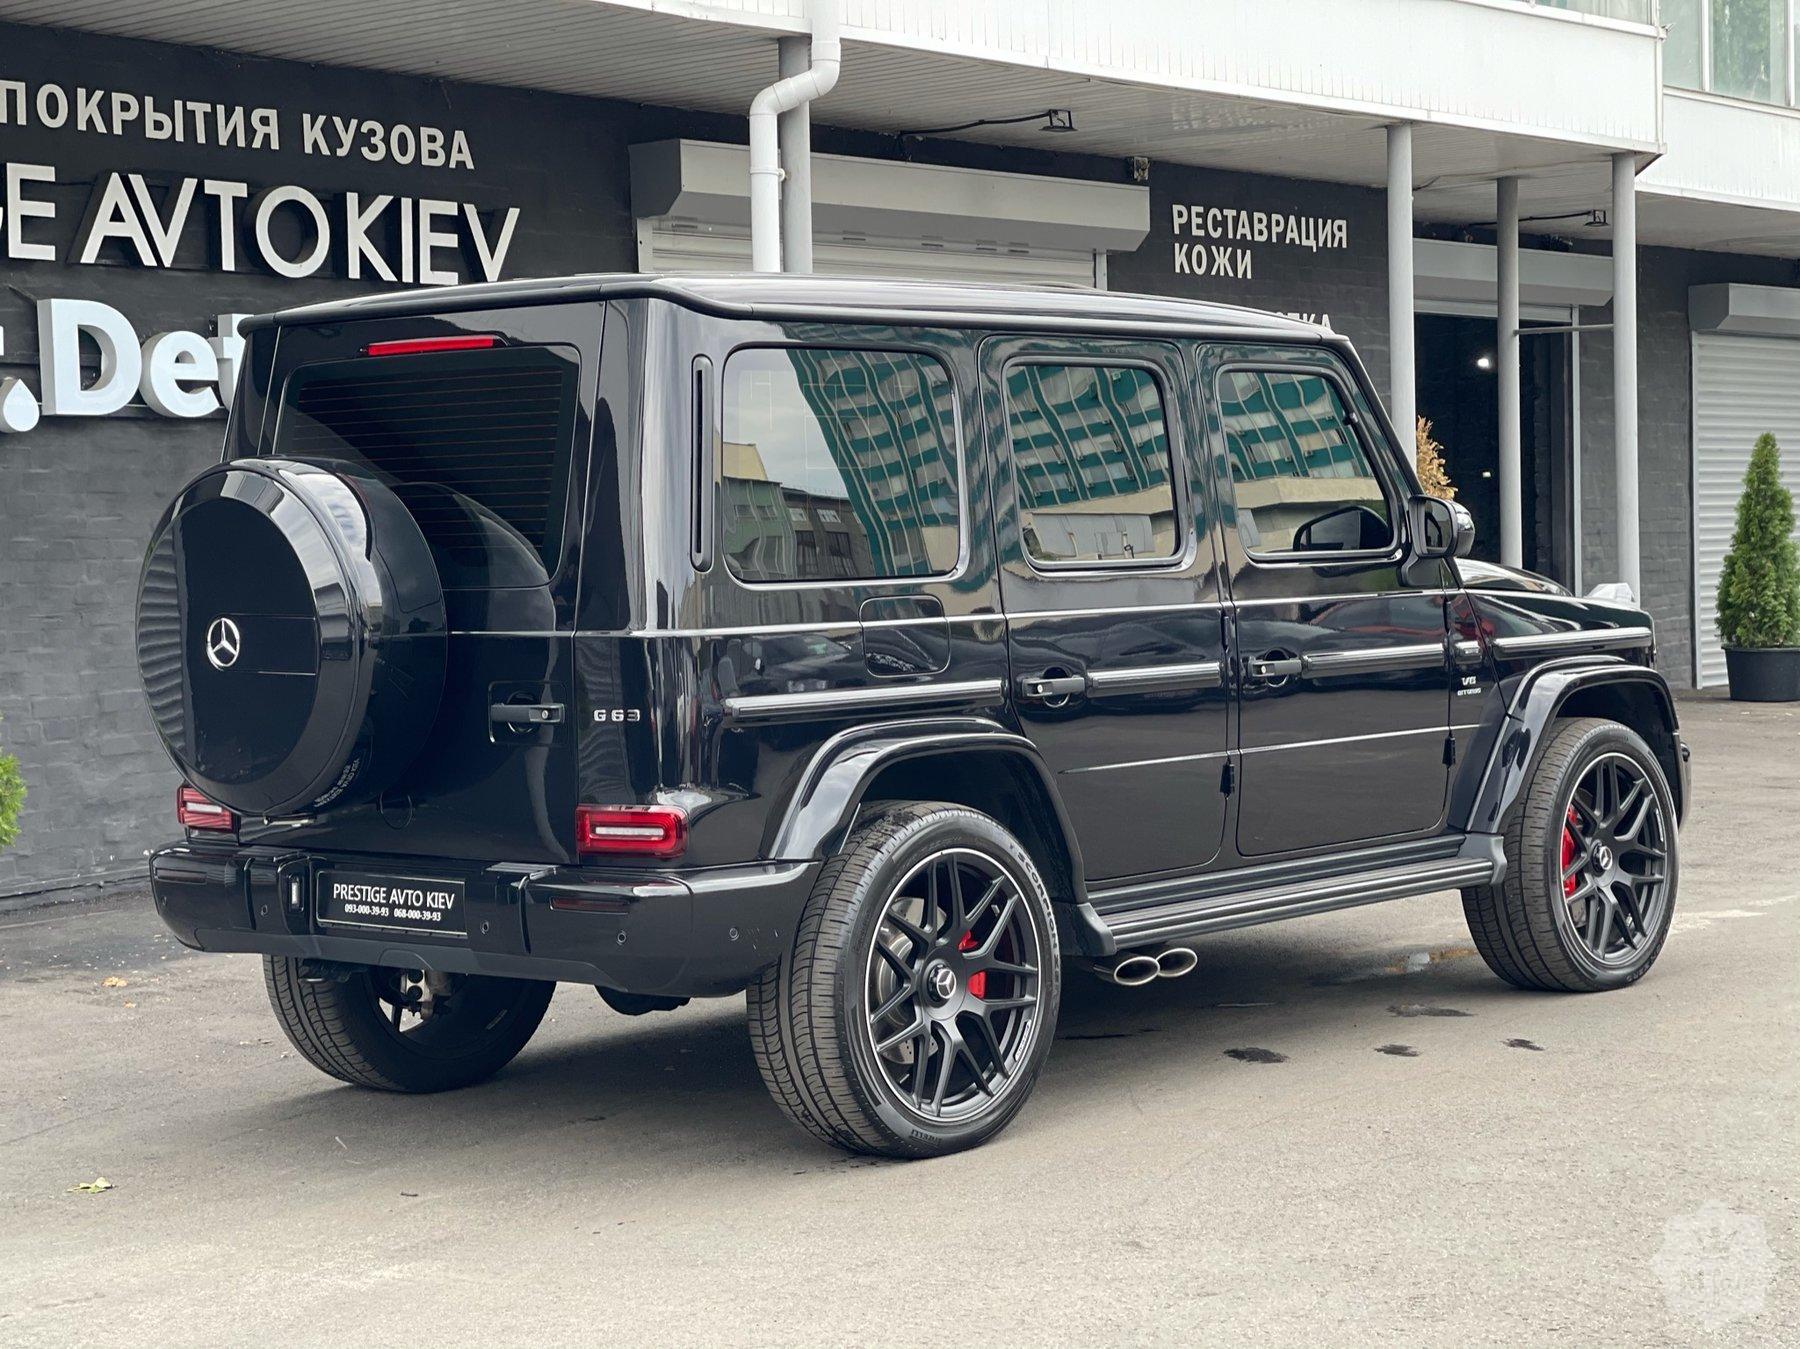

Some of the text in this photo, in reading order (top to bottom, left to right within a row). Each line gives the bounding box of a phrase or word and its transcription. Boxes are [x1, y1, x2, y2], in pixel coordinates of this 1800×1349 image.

[0, 80, 475, 170] ПОКРЫТИЯ КУЗОВА
[0, 162, 56, 261] E
[1172, 204, 1347, 252] РЕСТАВРАЦИЯ
[1174, 243, 1252, 279] КОЖИ
[333, 883, 455, 910] PRESTIGE AVTO KIEV
[344, 903, 442, 922] 093-000-39-93 068-000-39-93
